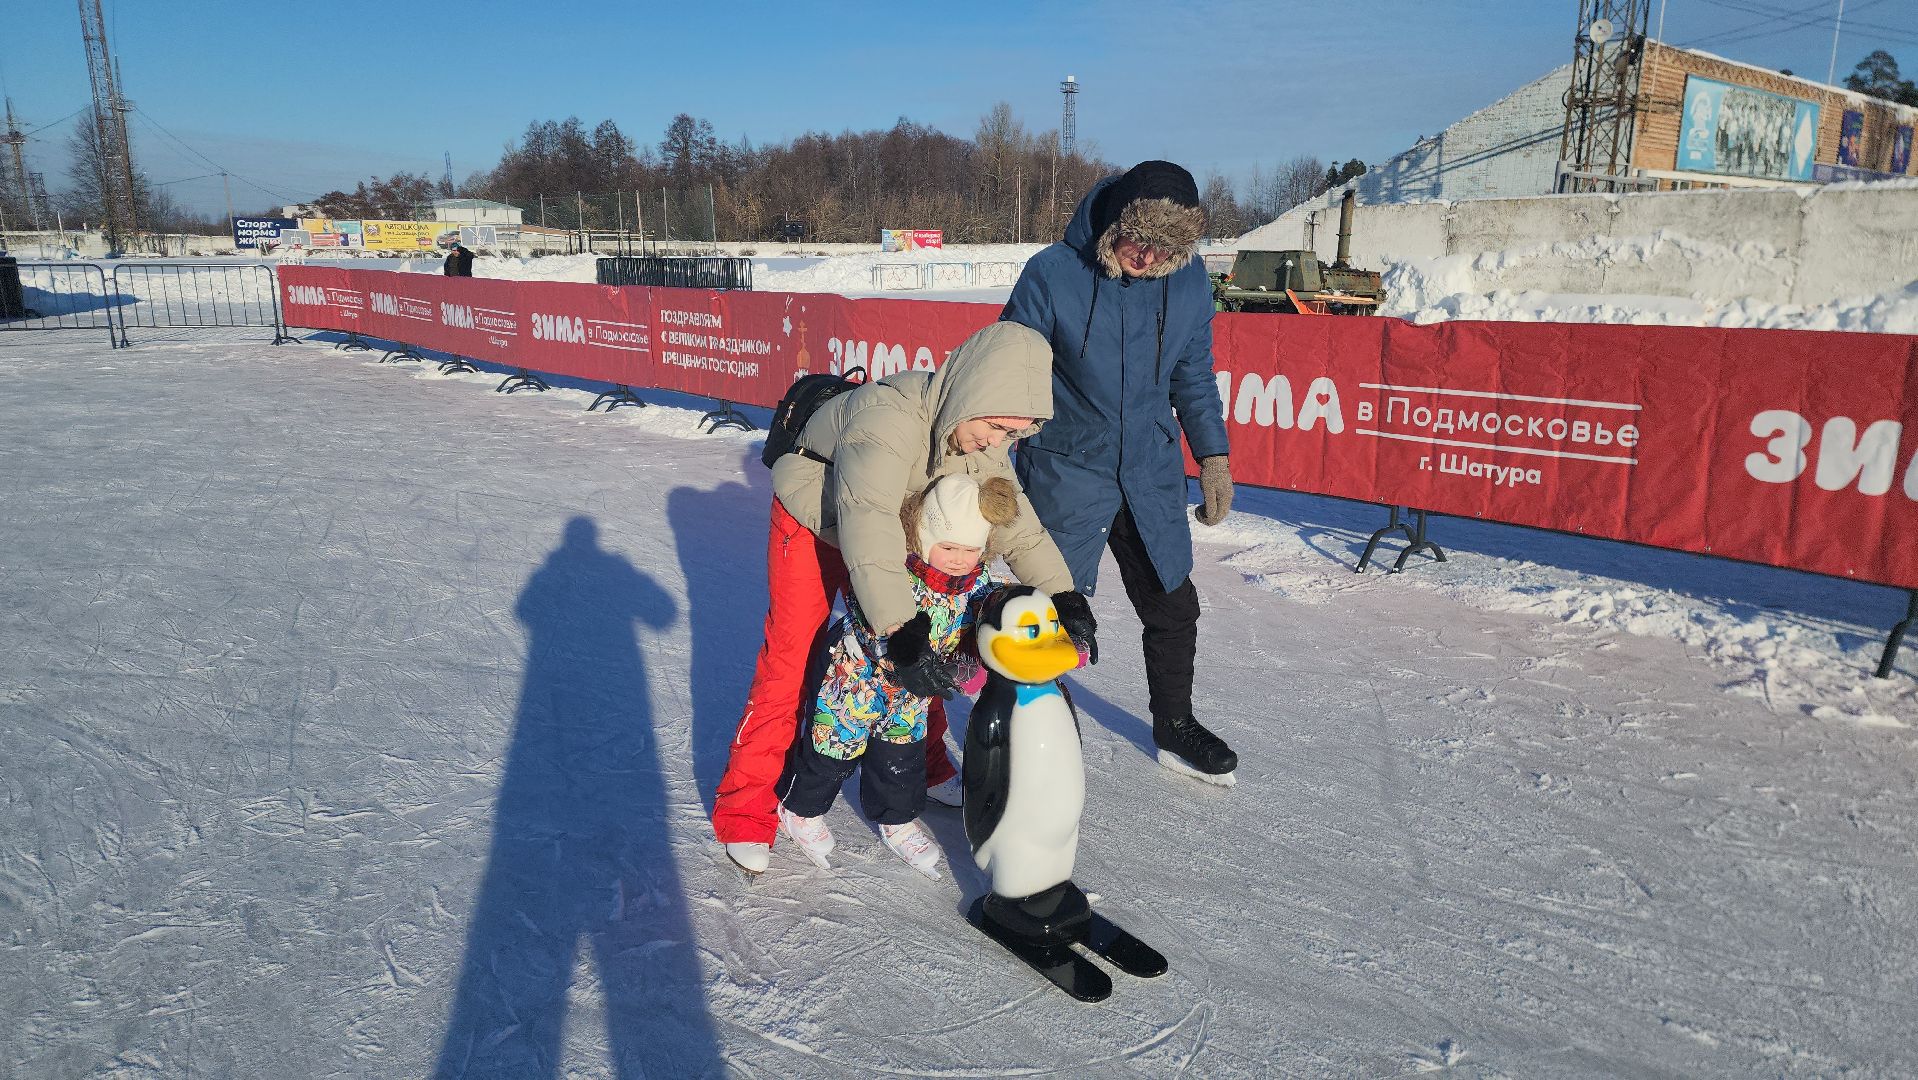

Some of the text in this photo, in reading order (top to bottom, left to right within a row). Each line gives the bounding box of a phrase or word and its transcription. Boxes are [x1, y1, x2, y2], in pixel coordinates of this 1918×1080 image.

[237, 220, 273, 230] Спорт
[238, 229, 277, 237] норма
[287, 284, 327, 306] ЗИМА
[370, 291, 400, 316] ЗИМА
[440, 301, 475, 330] ЗИМА
[531, 312, 586, 345] ЗИМА
[660, 309, 722, 329] ПОЗДРАВЛЯЕМ
[668, 331, 707, 348] ВЕЛИКИМ
[709, 335, 771, 356] ПРАЗДНИКОМ
[662, 350, 760, 378] КРЕЩЕНИЯ ГОСПОДНЯ!
[828, 337, 936, 383] ЗИМА
[1357, 401, 1374, 421] в
[1387, 396, 1640, 448] Подмосковье
[1745, 409, 1918, 502] ЗИ
[1419, 453, 1542, 488] г. Шатура
